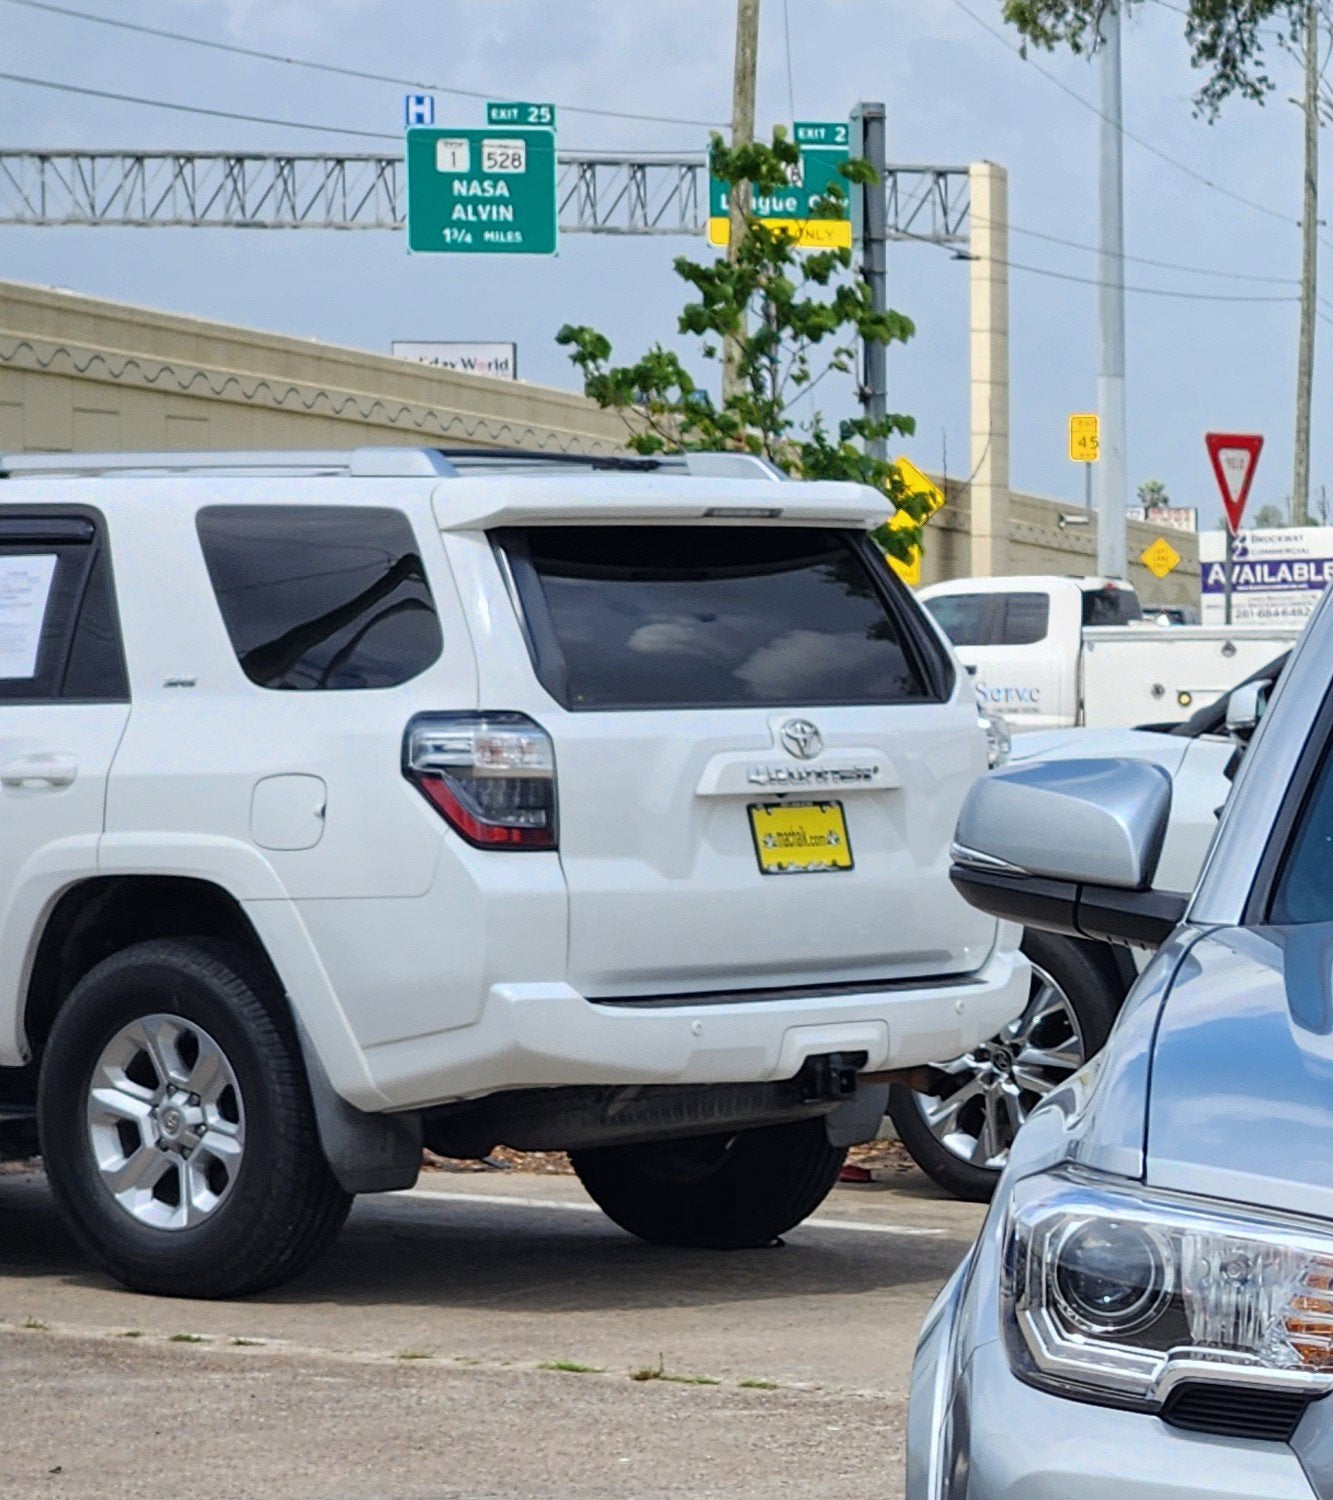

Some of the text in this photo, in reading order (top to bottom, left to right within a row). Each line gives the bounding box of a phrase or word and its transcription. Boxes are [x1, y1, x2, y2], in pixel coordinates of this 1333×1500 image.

[490, 107, 551, 123] EXIT 25
[797, 128, 826, 139] EXIT
[486, 152, 522, 169] 528
[452, 179, 510, 197] NASA
[720, 193, 798, 215] Lgue
[451, 204, 514, 222] ALVIN
[483, 231, 523, 243] MILES
[1078, 436, 1099, 450] 45
